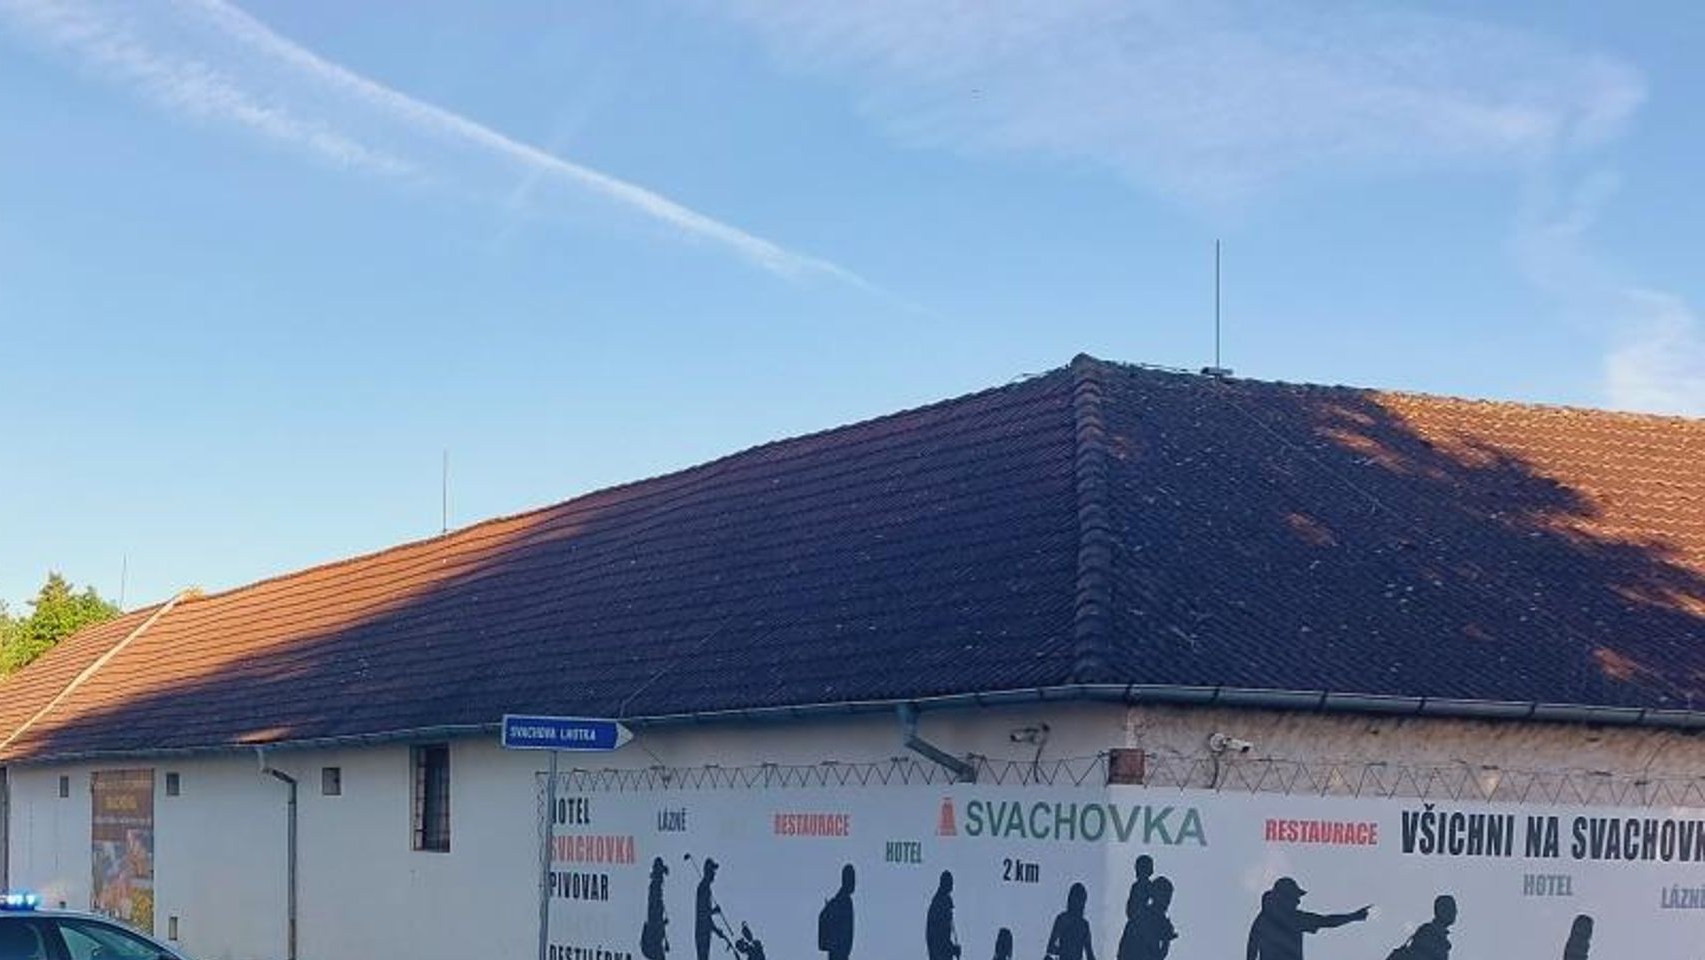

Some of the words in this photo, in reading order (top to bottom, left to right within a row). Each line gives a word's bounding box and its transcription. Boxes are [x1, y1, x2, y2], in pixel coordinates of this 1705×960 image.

[559, 728, 596, 741] LHOTKA
[774, 813, 851, 837] RESTAURACE
[964, 799, 1207, 846] SVACHOVKA
[1265, 818, 1378, 845] RESTAURACE
[1401, 803, 1515, 857] VŠICHNI
[1525, 815, 1560, 859] NA
[886, 841, 923, 864] HOTEL
[1002, 858, 1014, 882] 2
[1015, 859, 1040, 884] km
[550, 871, 610, 902] PIVOVAR
[1523, 873, 1574, 897] HOTEL
